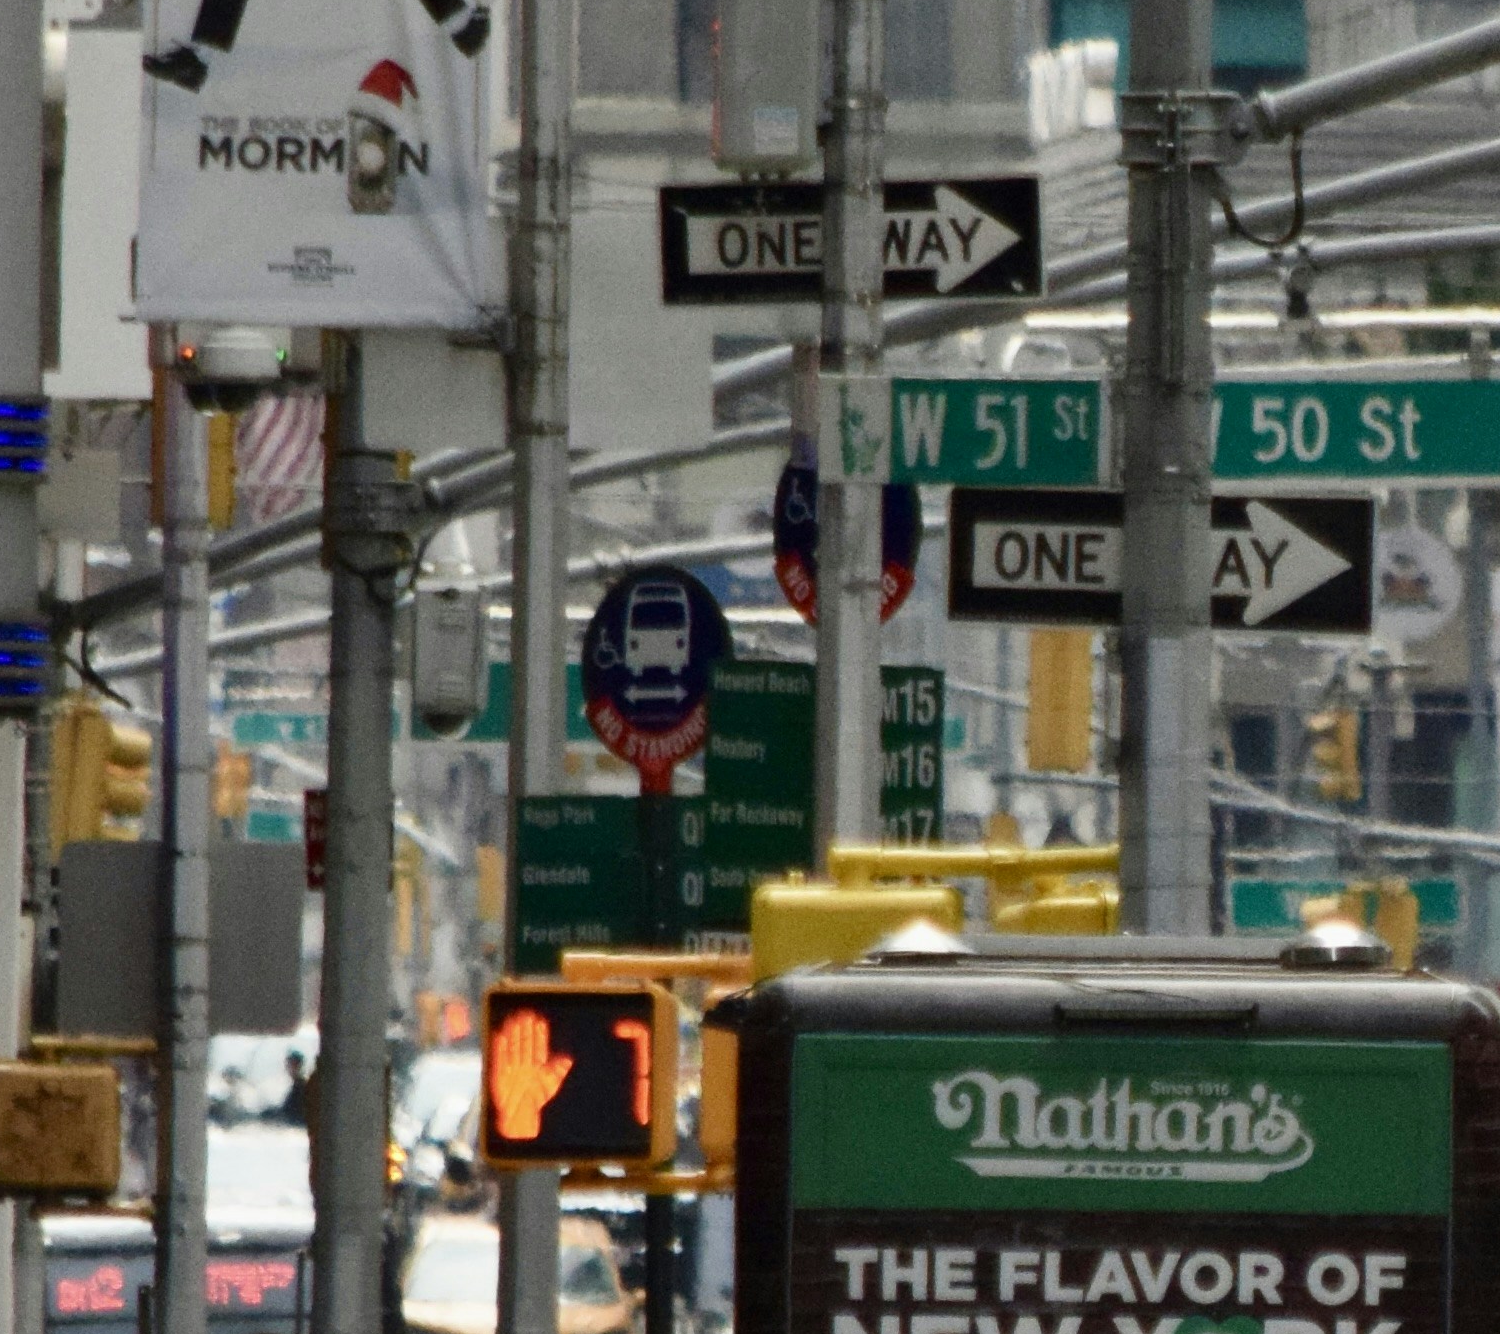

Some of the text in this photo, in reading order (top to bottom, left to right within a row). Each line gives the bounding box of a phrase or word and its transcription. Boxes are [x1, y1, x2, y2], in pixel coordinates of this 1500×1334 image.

[717, 218, 982, 269] ONE WAY
[901, 395, 1090, 469] W 51 St
[1251, 398, 1328, 465] 50
[1359, 394, 1422, 463] St
[994, 532, 1106, 584] ONE
[613, 1019, 651, 1126] 7
[1150, 1081, 1193, 1098] Since
[932, 1071, 1312, 1157] Nathan's
[1063, 1164, 1185, 1178] FAMOUS
[835, 1248, 1406, 1307] THE FLAVOR OF
